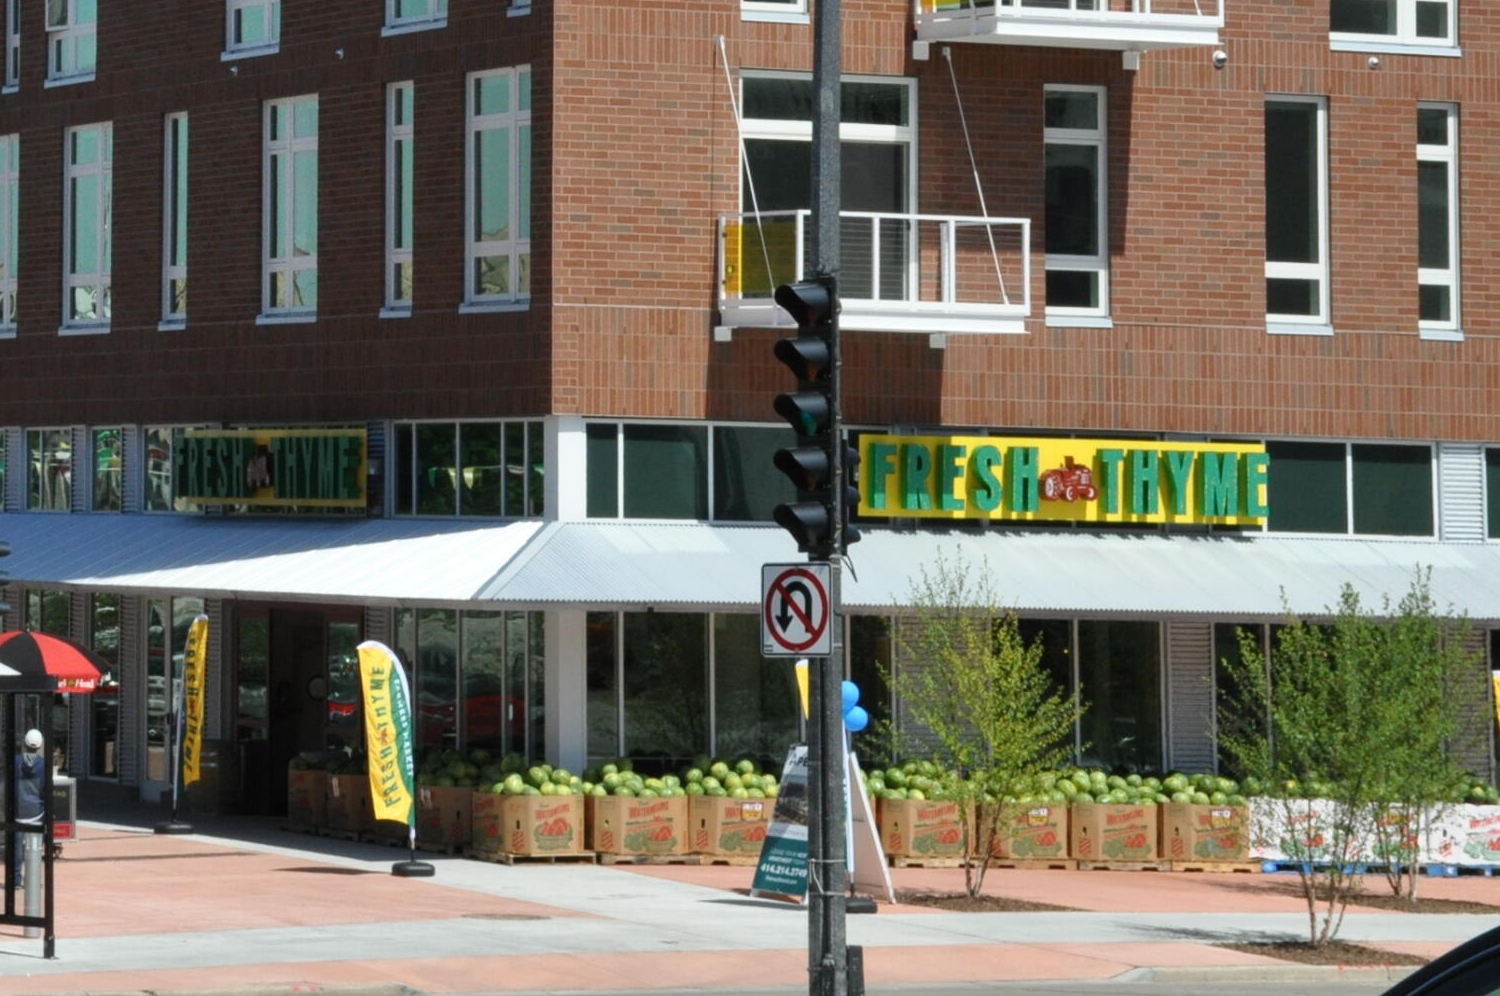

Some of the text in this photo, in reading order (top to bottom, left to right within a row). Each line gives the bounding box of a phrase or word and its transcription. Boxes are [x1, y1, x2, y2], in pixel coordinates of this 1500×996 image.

[175, 433, 358, 500] FRESH THYME
[867, 442, 1271, 518] FRESH THYME
[370, 666, 402, 808] FRESH THYME
